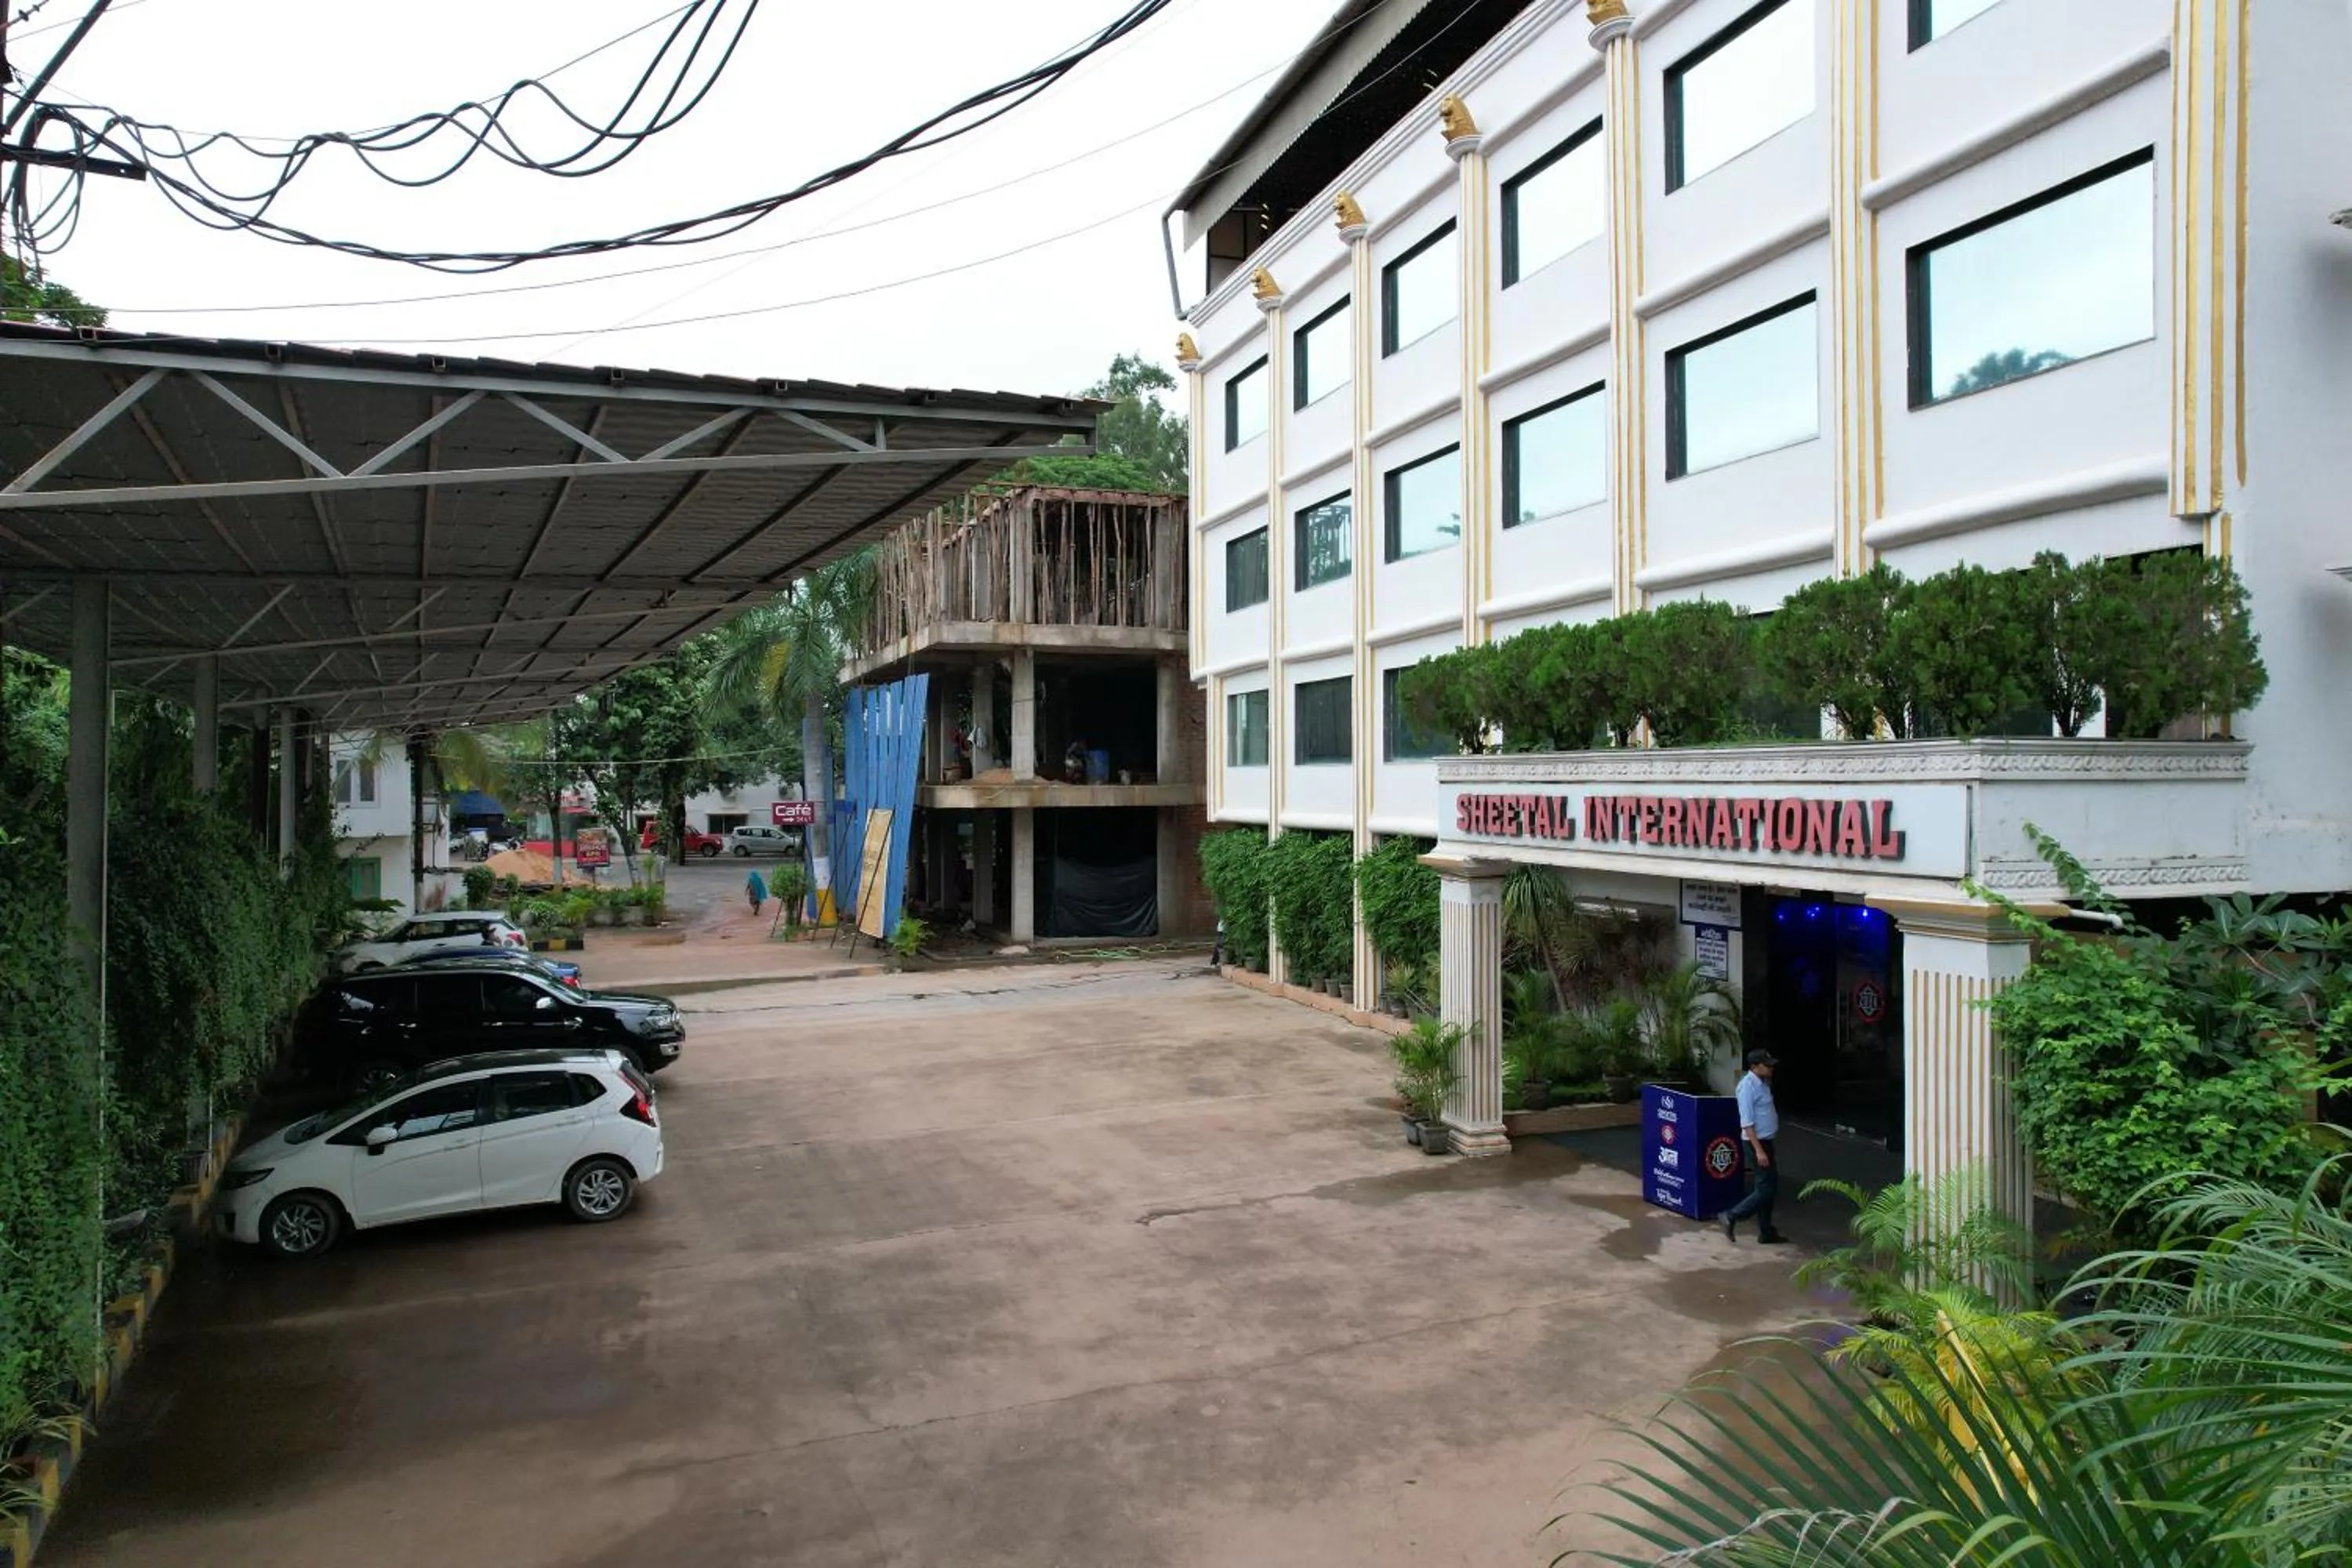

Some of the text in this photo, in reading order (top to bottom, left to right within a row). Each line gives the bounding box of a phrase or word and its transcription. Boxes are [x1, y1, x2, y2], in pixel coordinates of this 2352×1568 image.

[775, 803, 811, 816] Café
[1456, 793, 1900, 859] SHEETAL INTERNATIONAL
